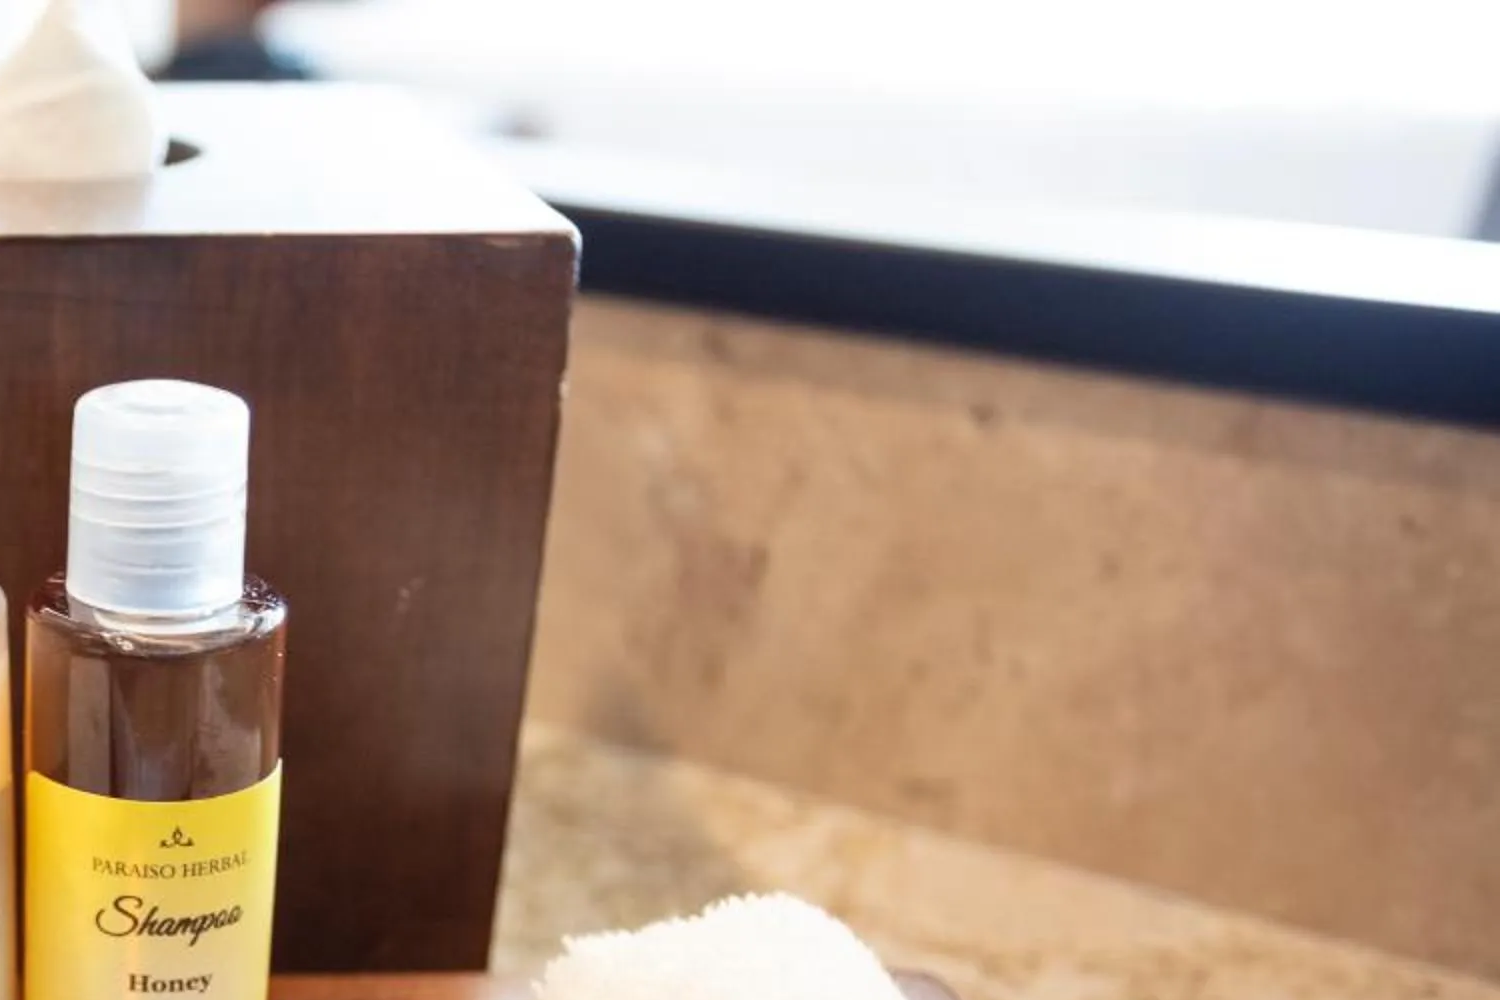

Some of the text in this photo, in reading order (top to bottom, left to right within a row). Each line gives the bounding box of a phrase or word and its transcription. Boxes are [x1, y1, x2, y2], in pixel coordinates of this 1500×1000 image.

[92, 849, 250, 880] PARAISO HERBAL
[95, 894, 243, 947] Shampoo
[128, 973, 213, 994] Honey
